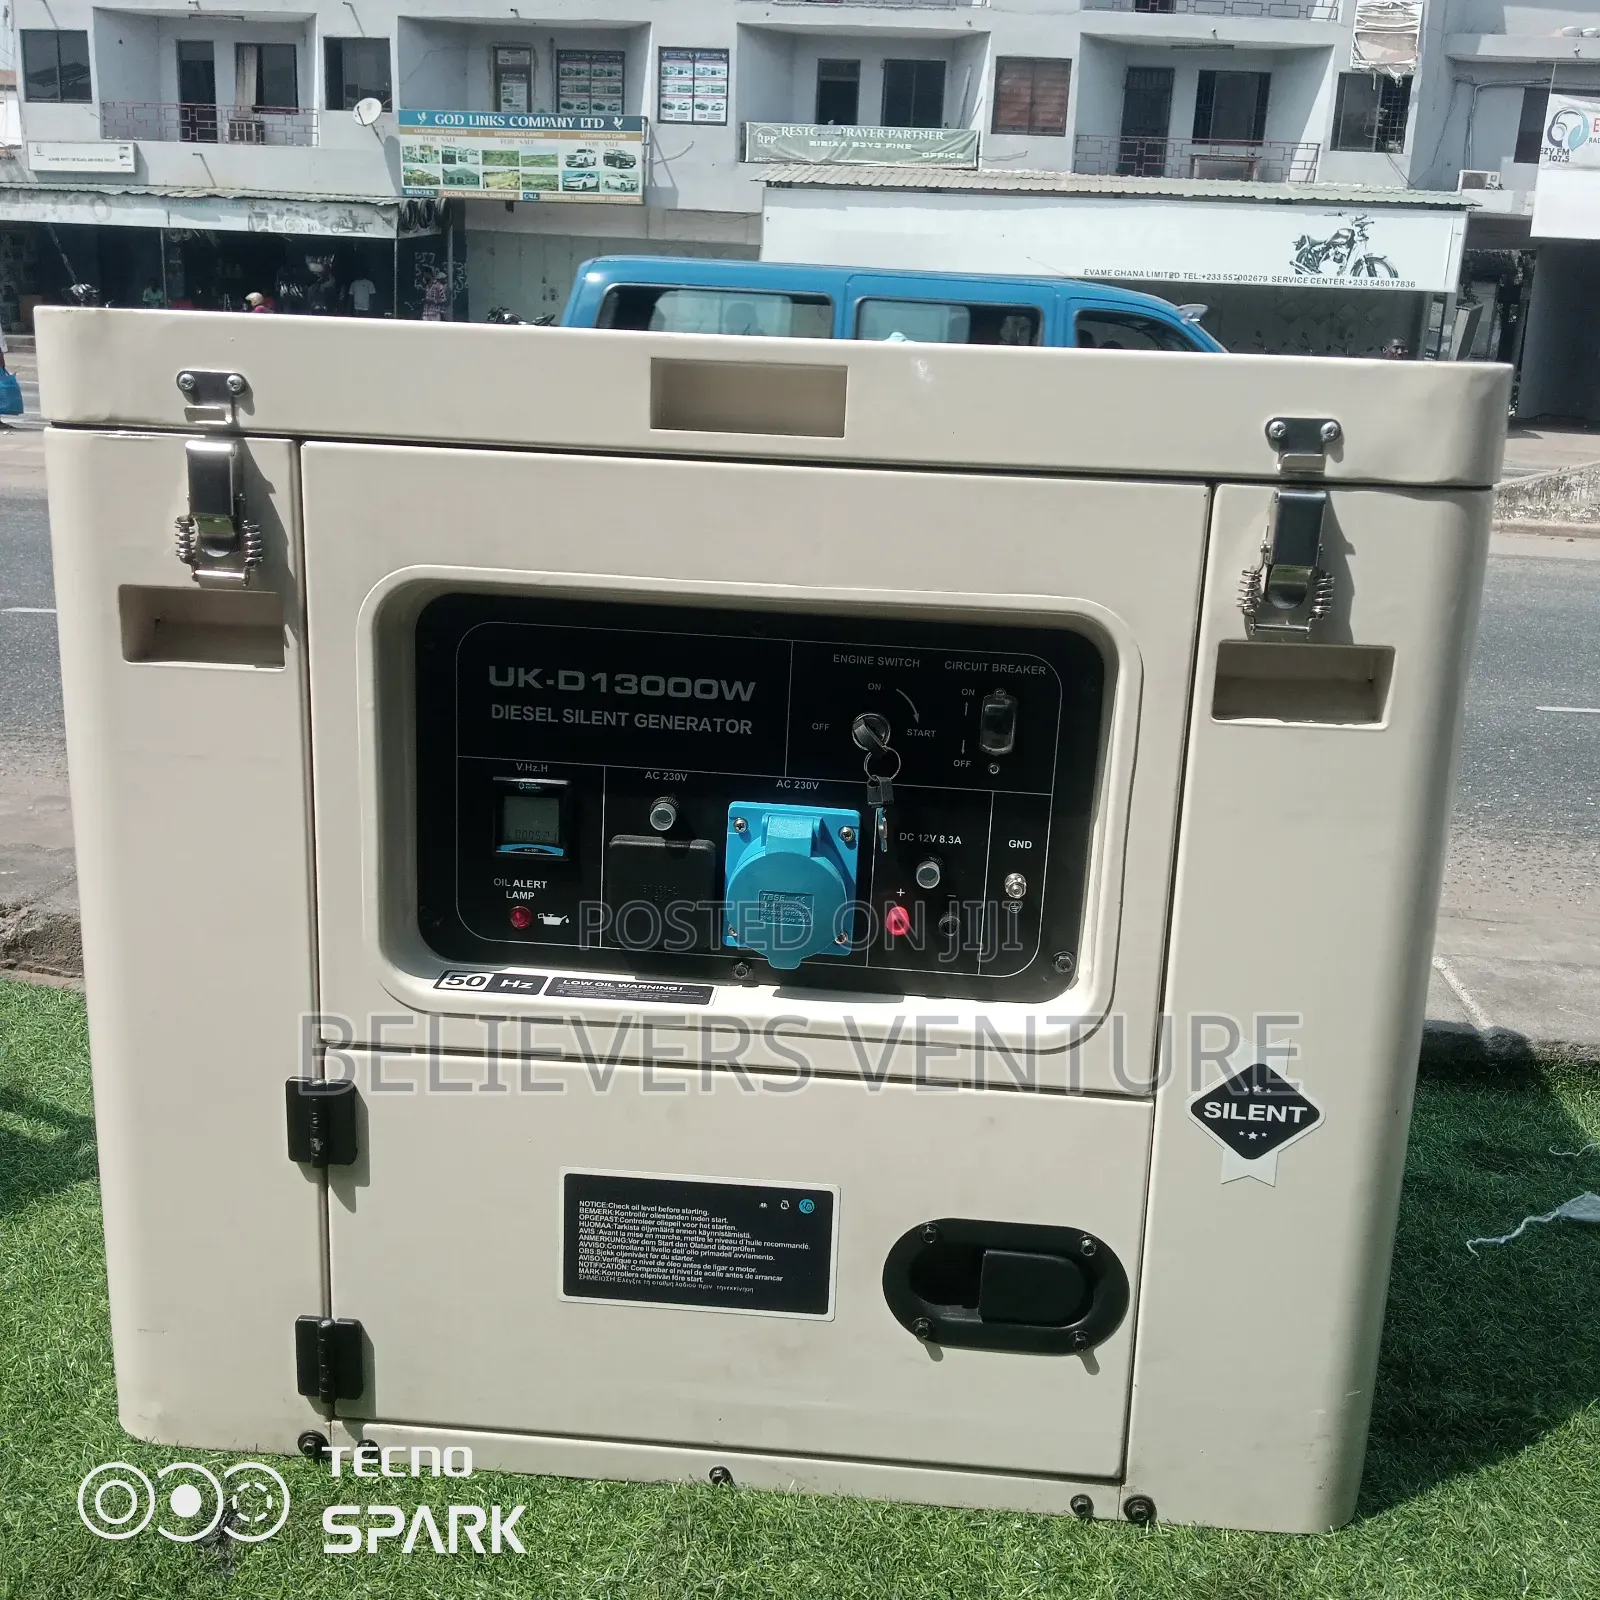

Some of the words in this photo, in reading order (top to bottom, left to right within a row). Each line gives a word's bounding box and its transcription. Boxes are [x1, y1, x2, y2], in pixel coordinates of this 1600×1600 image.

[434, 114, 465, 125] GOD
[469, 115, 505, 126] LINKS
[509, 115, 576, 128] COMPANY
[580, 117, 605, 129] LTD
[888, 128, 945, 140] PARTNER
[885, 142, 912, 150] FINE
[1556, 148, 1570, 156] FM
[1083, 268, 1112, 276] EVAME
[1114, 269, 1144, 278] GHANA
[1271, 276, 1309, 285] SERVICE
[1370, 280, 1416, 288] 545017836
[833, 654, 875, 665] ENGINE
[877, 656, 921, 668] SWITCH
[944, 660, 989, 673] CIRCUIT
[992, 664, 1046, 676] BREAKER
[867, 682, 882, 692] ON
[961, 688, 975, 697] ON
[491, 704, 558, 723] DIESEL
[562, 708, 629, 727] SILENT
[634, 713, 753, 735] GENERATOR
[811, 722, 830, 731] OFF
[906, 728, 936, 738] START
[953, 759, 972, 768] OFF
[645, 771, 660, 780] AC
[663, 773, 688, 782] 230V
[776, 780, 791, 789] AC
[795, 781, 819, 790] 230V
[899, 832, 915, 842] DC
[918, 833, 937, 843] 12V
[939, 835, 962, 845] 8.3A
[1008, 839, 1032, 849] GND
[493, 878, 511, 888] OIL
[513, 879, 547, 889] ALERT
[506, 890, 535, 900] LAMP
[445, 974, 487, 988] 50
[500, 978, 535, 989] Hz
[562, 979, 594, 987] LOW
[618, 982, 684, 992] WARNING!
[1203, 1101, 1308, 1124] SILENT
[641, 1204, 657, 1212] level
[658, 1206, 680, 1214] before
[681, 1208, 710, 1216] starting.
[578, 1227, 595, 1235] AVIS
[630, 1265, 669, 1274] Comprobar
[703, 1270, 724, 1278] aceite
[754, 1274, 784, 1282] arrancar
[712, 1264, 729, 1272] ligar
